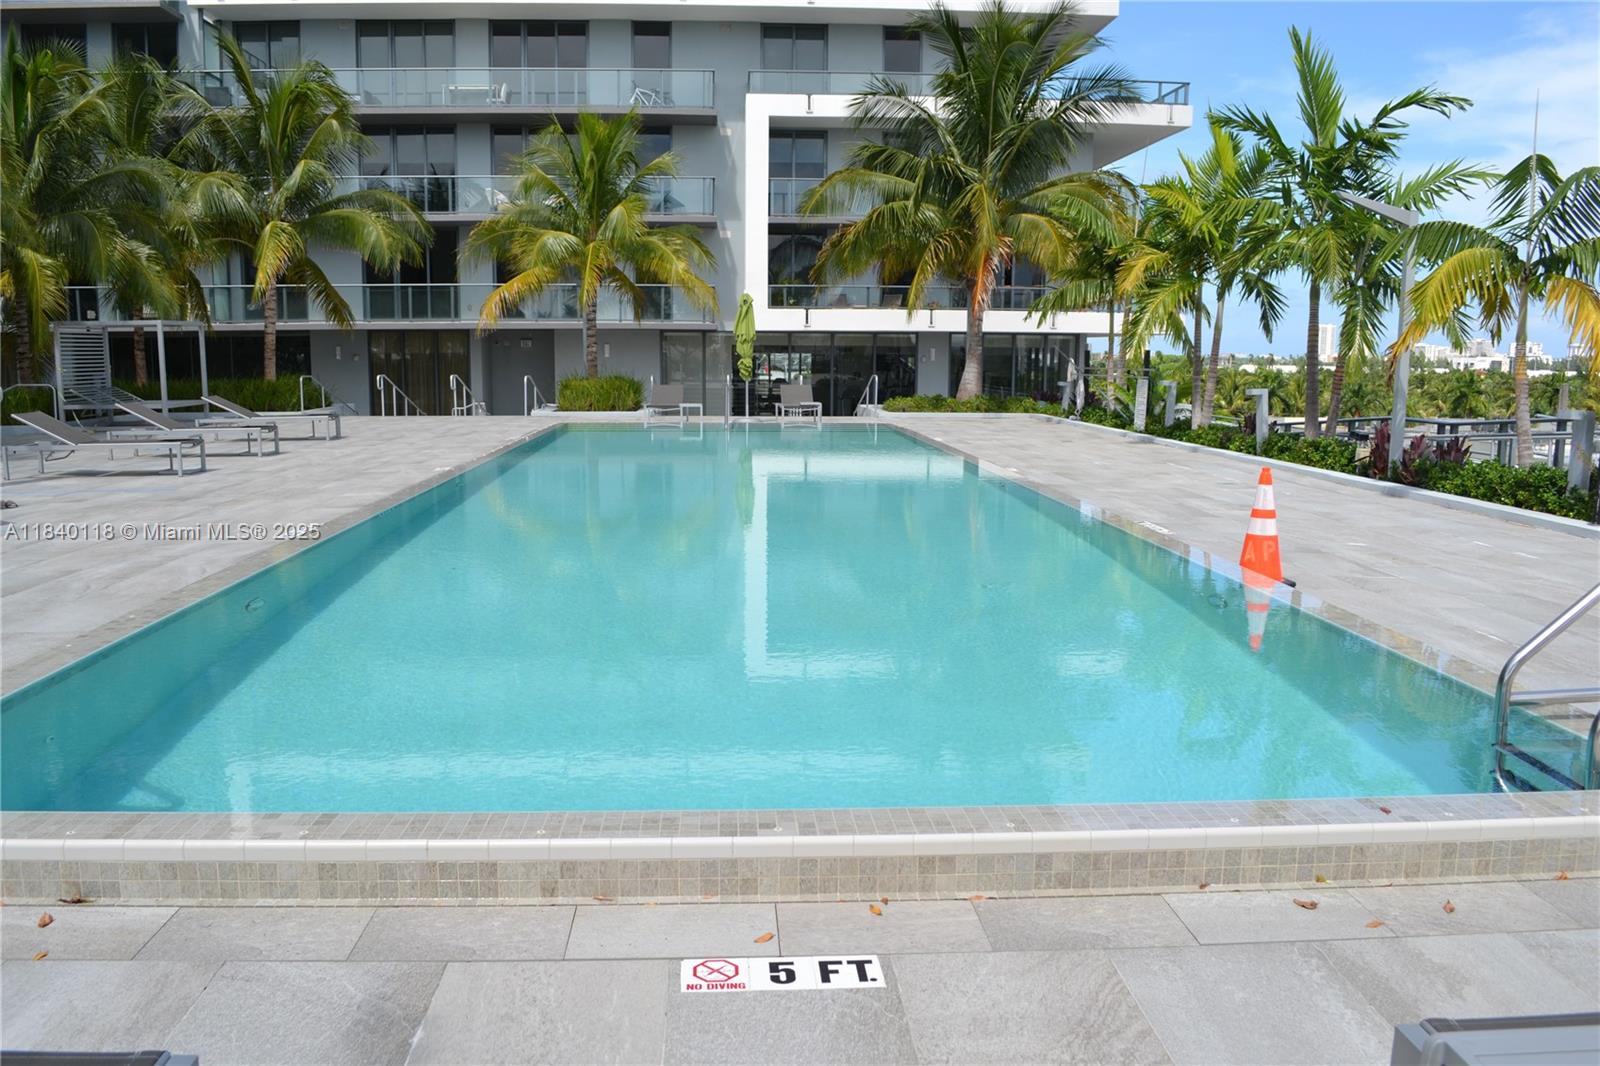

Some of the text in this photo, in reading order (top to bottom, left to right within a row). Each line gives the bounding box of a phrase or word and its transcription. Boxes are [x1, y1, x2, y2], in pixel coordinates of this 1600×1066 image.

[768, 959, 878, 985] 5 FT.
[686, 982, 746, 991] NO DIVING
